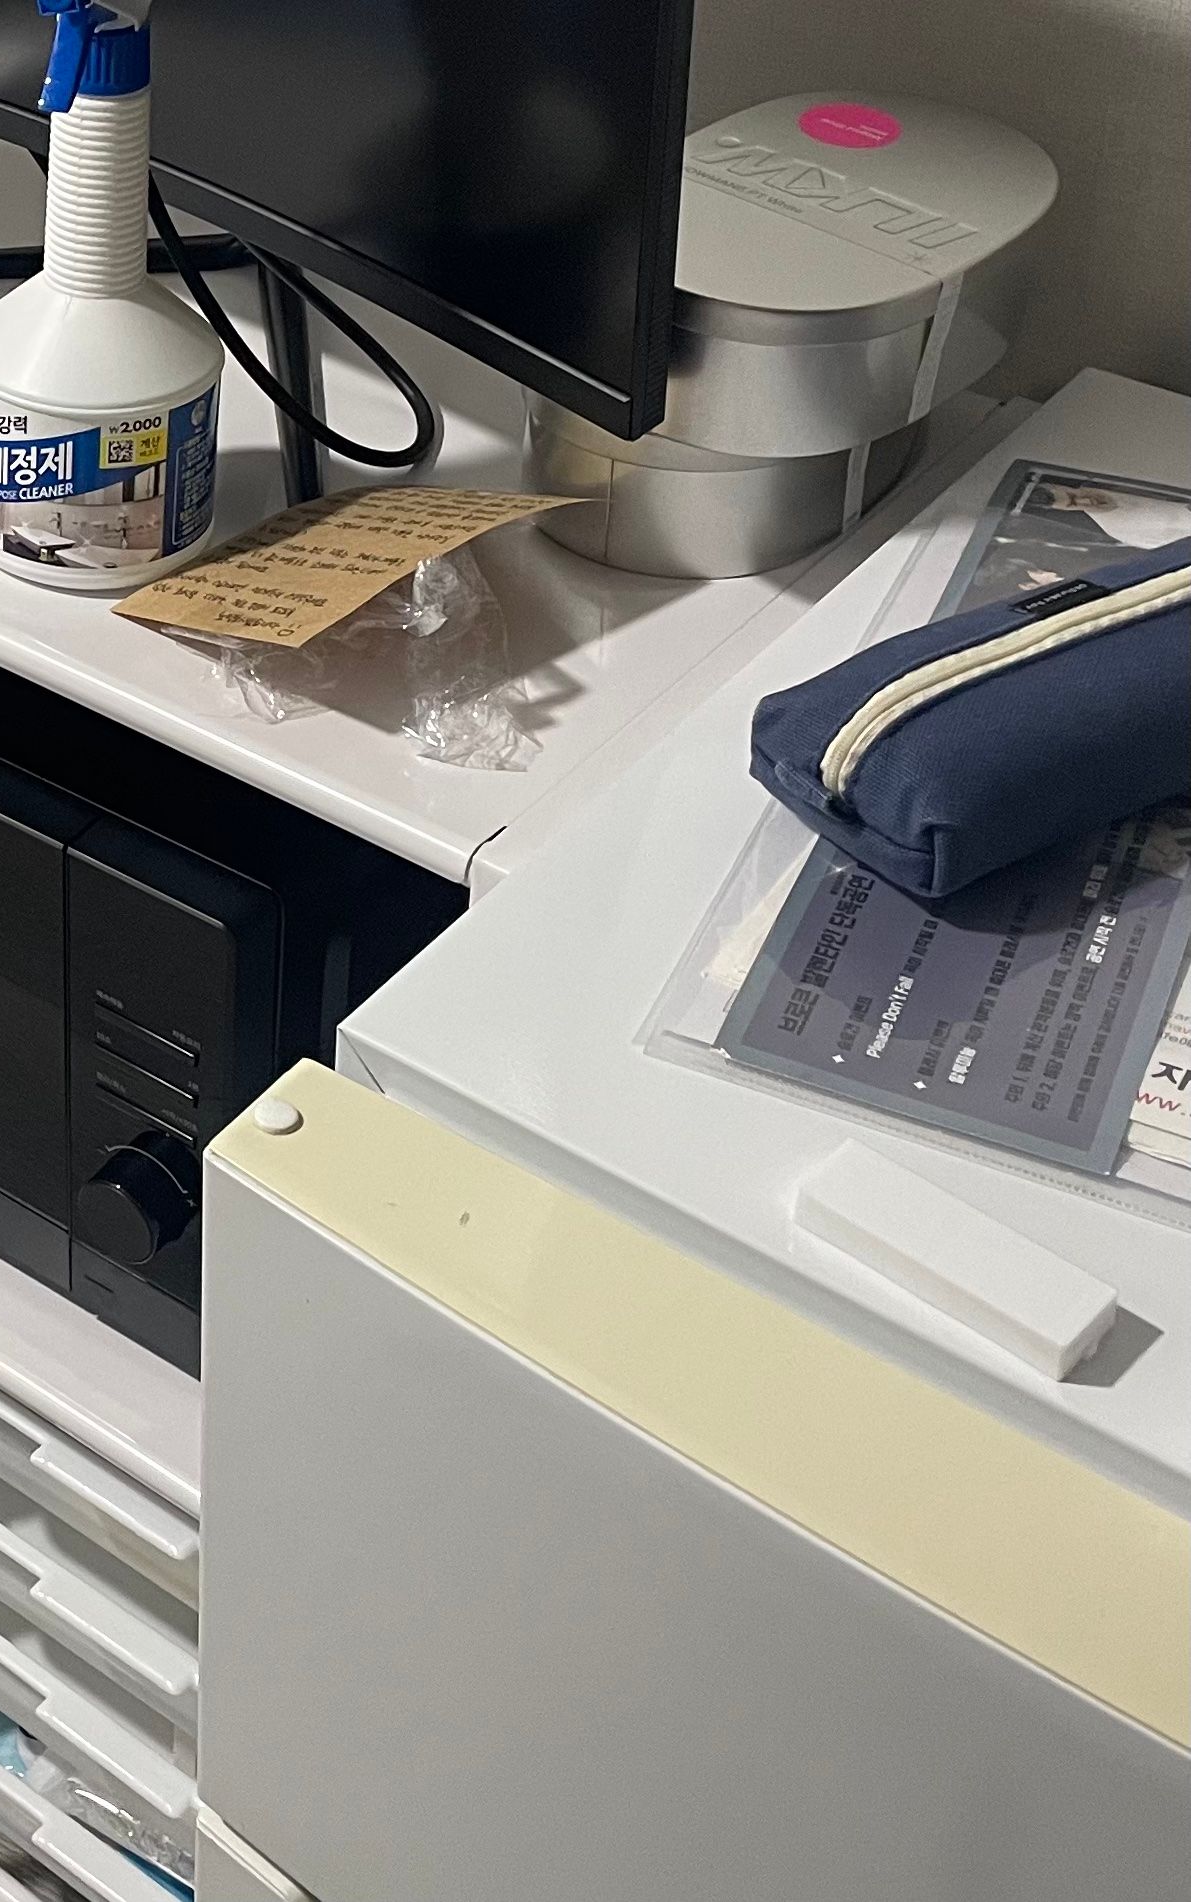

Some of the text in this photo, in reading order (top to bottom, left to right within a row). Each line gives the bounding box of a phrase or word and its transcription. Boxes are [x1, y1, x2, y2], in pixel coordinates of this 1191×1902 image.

[18, 482, 74, 500] CLEANER
[866, 1022, 894, 1059] Please
[882, 993, 907, 1022] Don't
